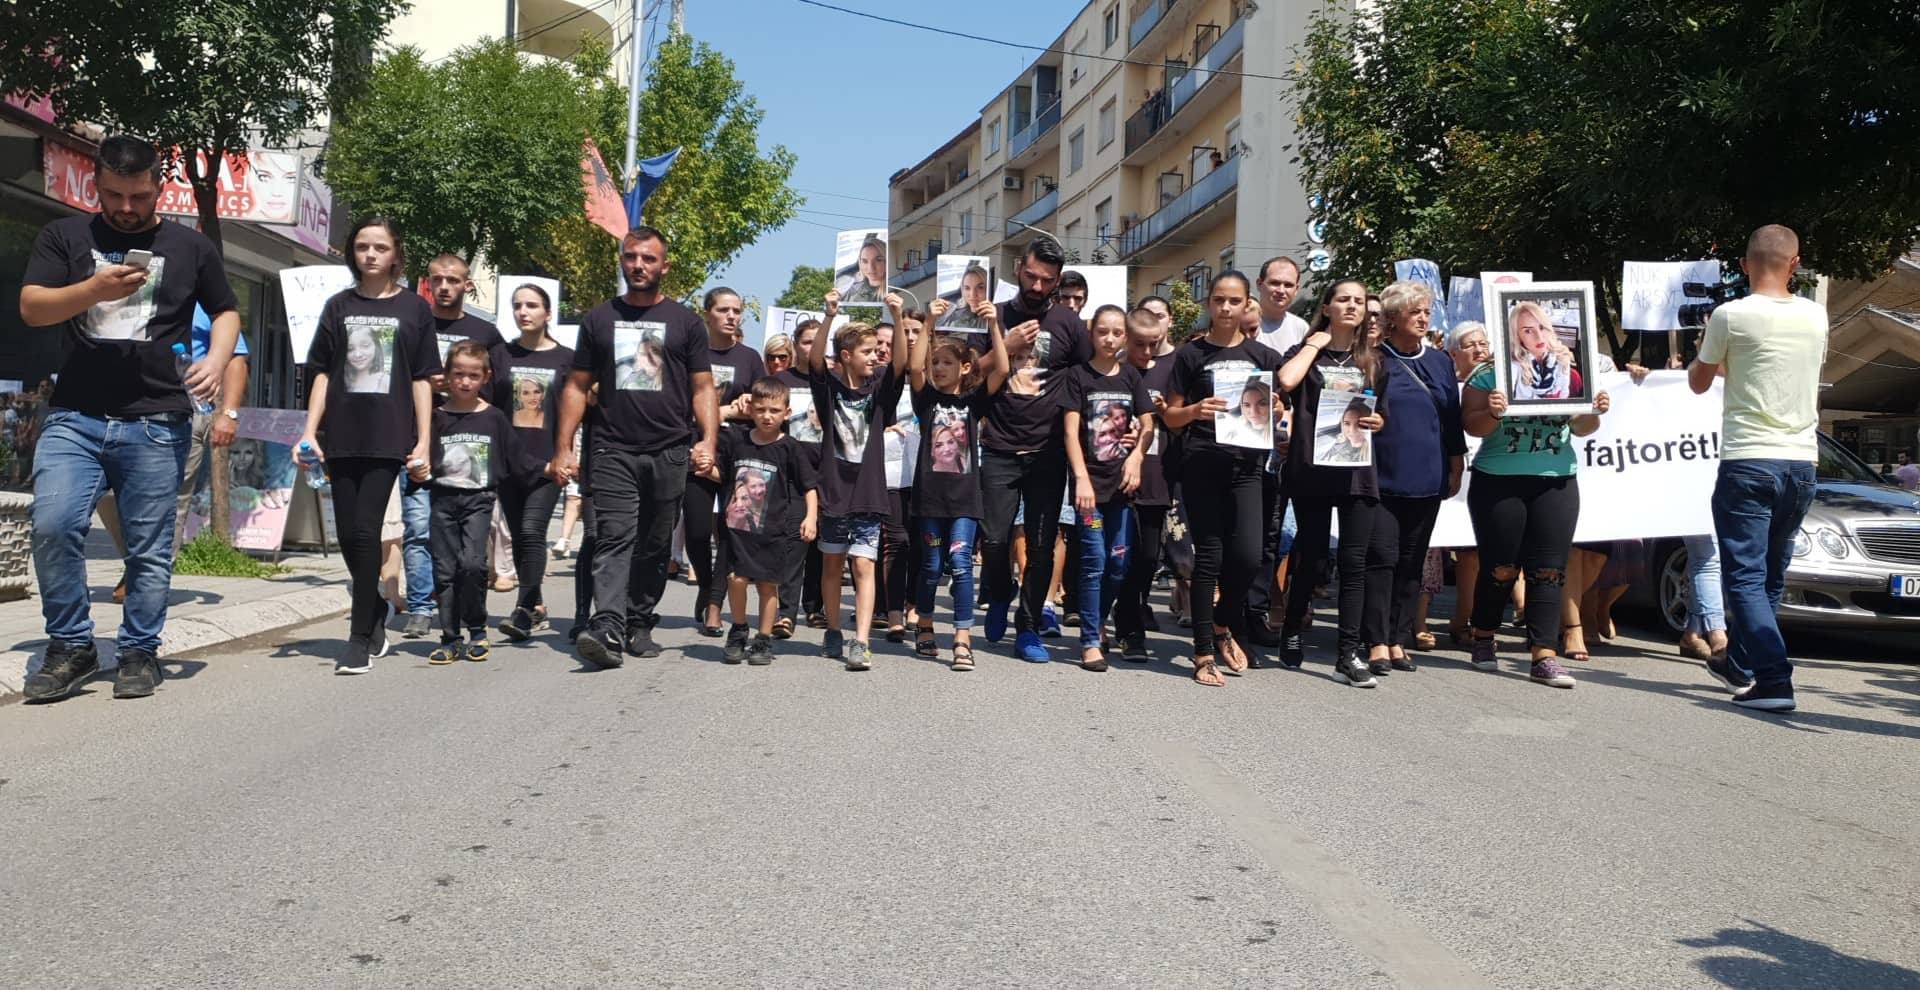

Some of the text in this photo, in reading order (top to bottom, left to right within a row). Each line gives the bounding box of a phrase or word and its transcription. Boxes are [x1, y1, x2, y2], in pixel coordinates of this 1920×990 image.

[65, 163, 102, 209] NO
[157, 190, 250, 211] SMICS
[1584, 432, 1720, 473] fajtorët!
